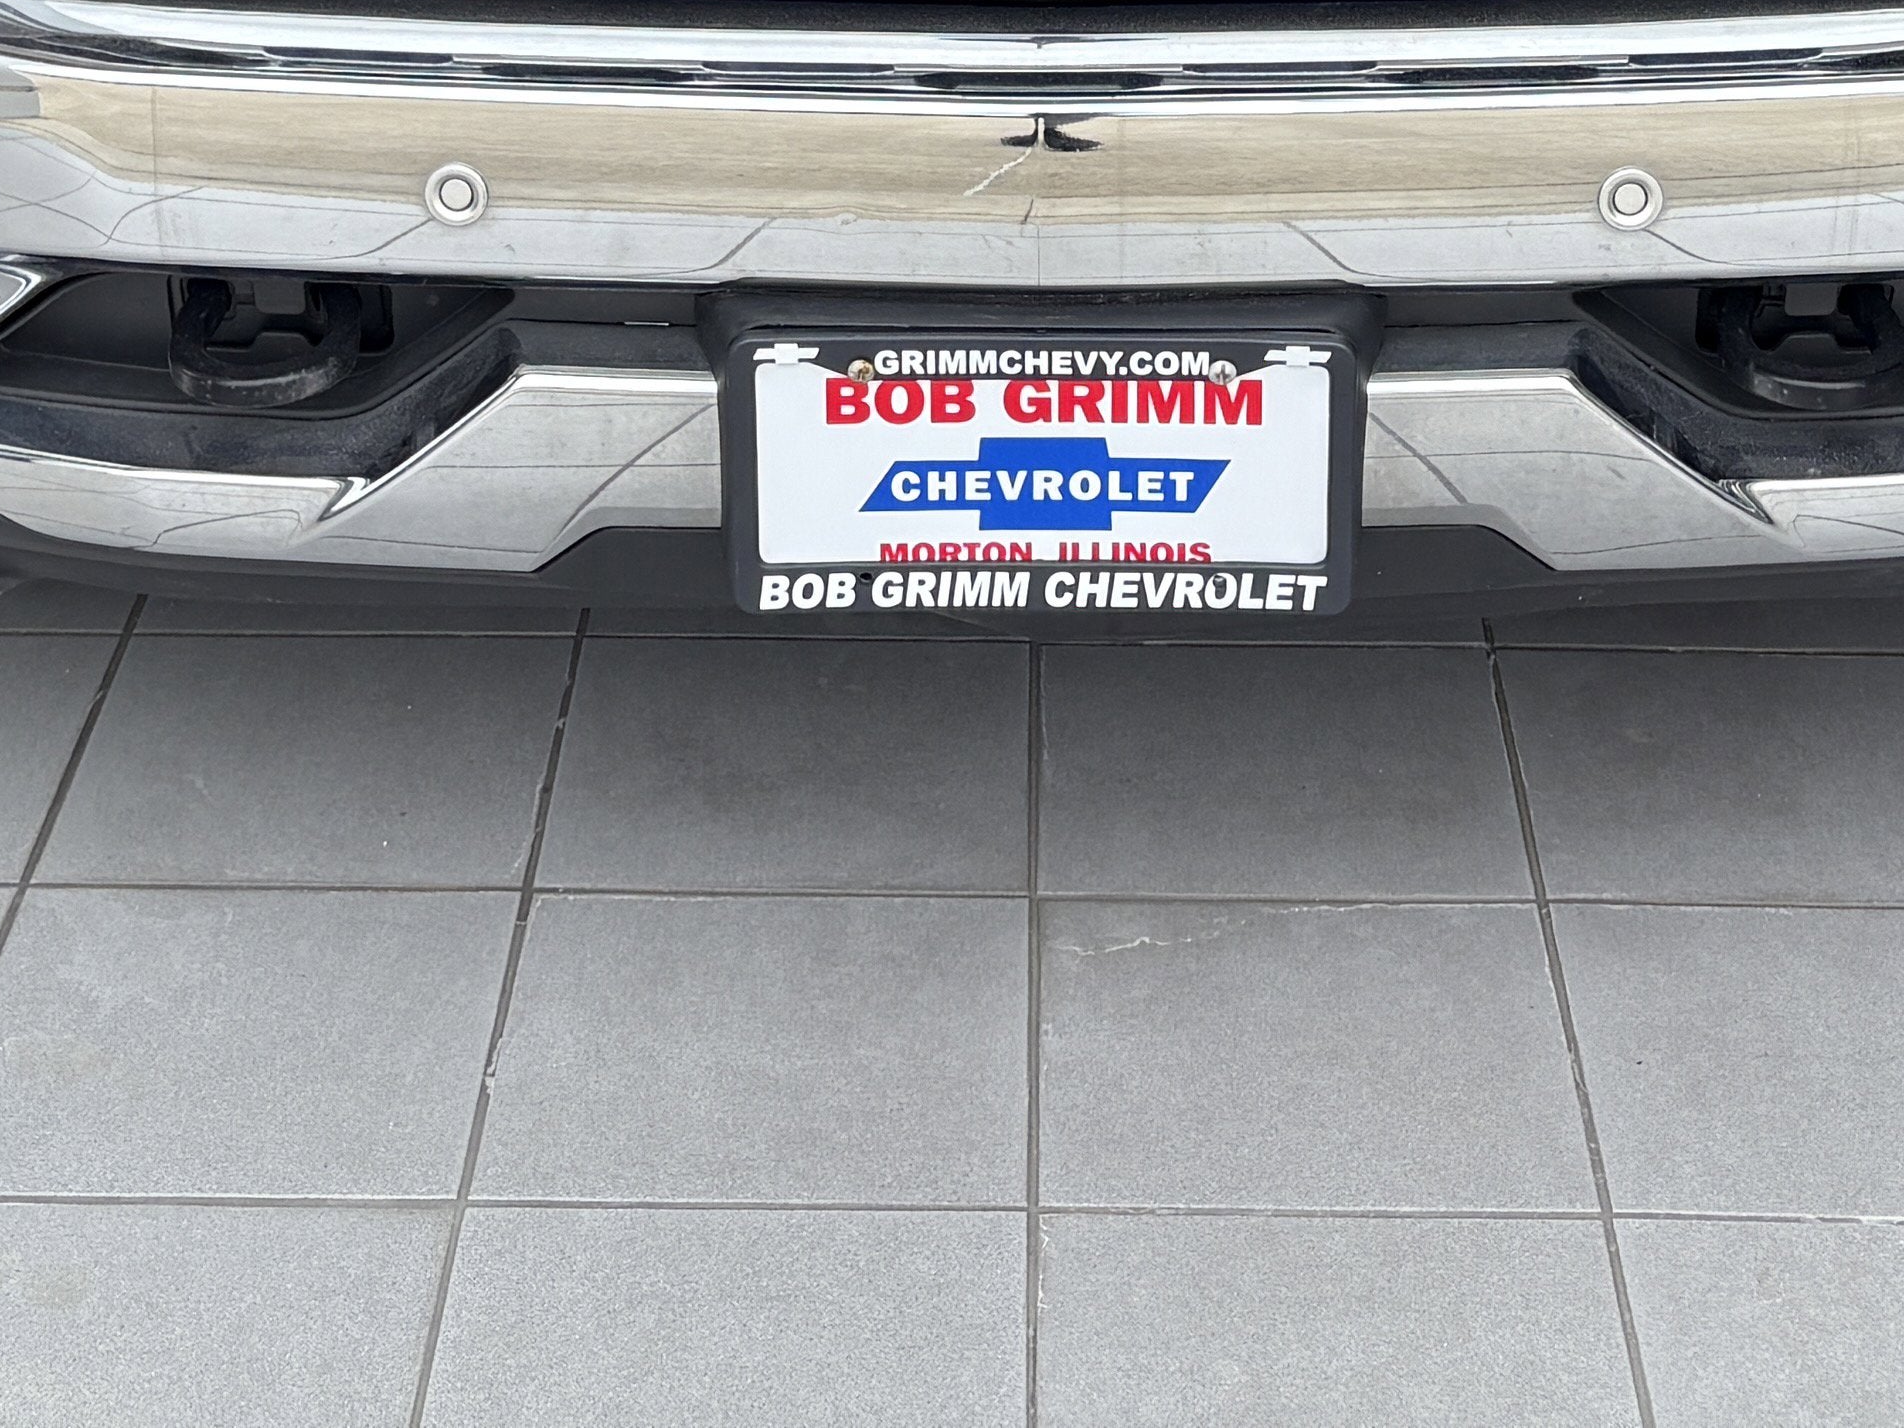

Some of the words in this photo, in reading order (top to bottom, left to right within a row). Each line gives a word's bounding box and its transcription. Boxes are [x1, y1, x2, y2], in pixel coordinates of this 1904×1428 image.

[874, 350, 1210, 376] GRIMMCHEVY.COM
[826, 378, 976, 424] BOB
[1003, 379, 1263, 425] GRIMM
[891, 470, 1195, 503] CHEVROLET
[880, 542, 1032, 562] MORTON
[1059, 542, 1211, 563] ILLINOIS
[760, 573, 856, 610] BOB
[872, 571, 1030, 608] GRIMM
[1045, 571, 1328, 611] CHEVROLET
